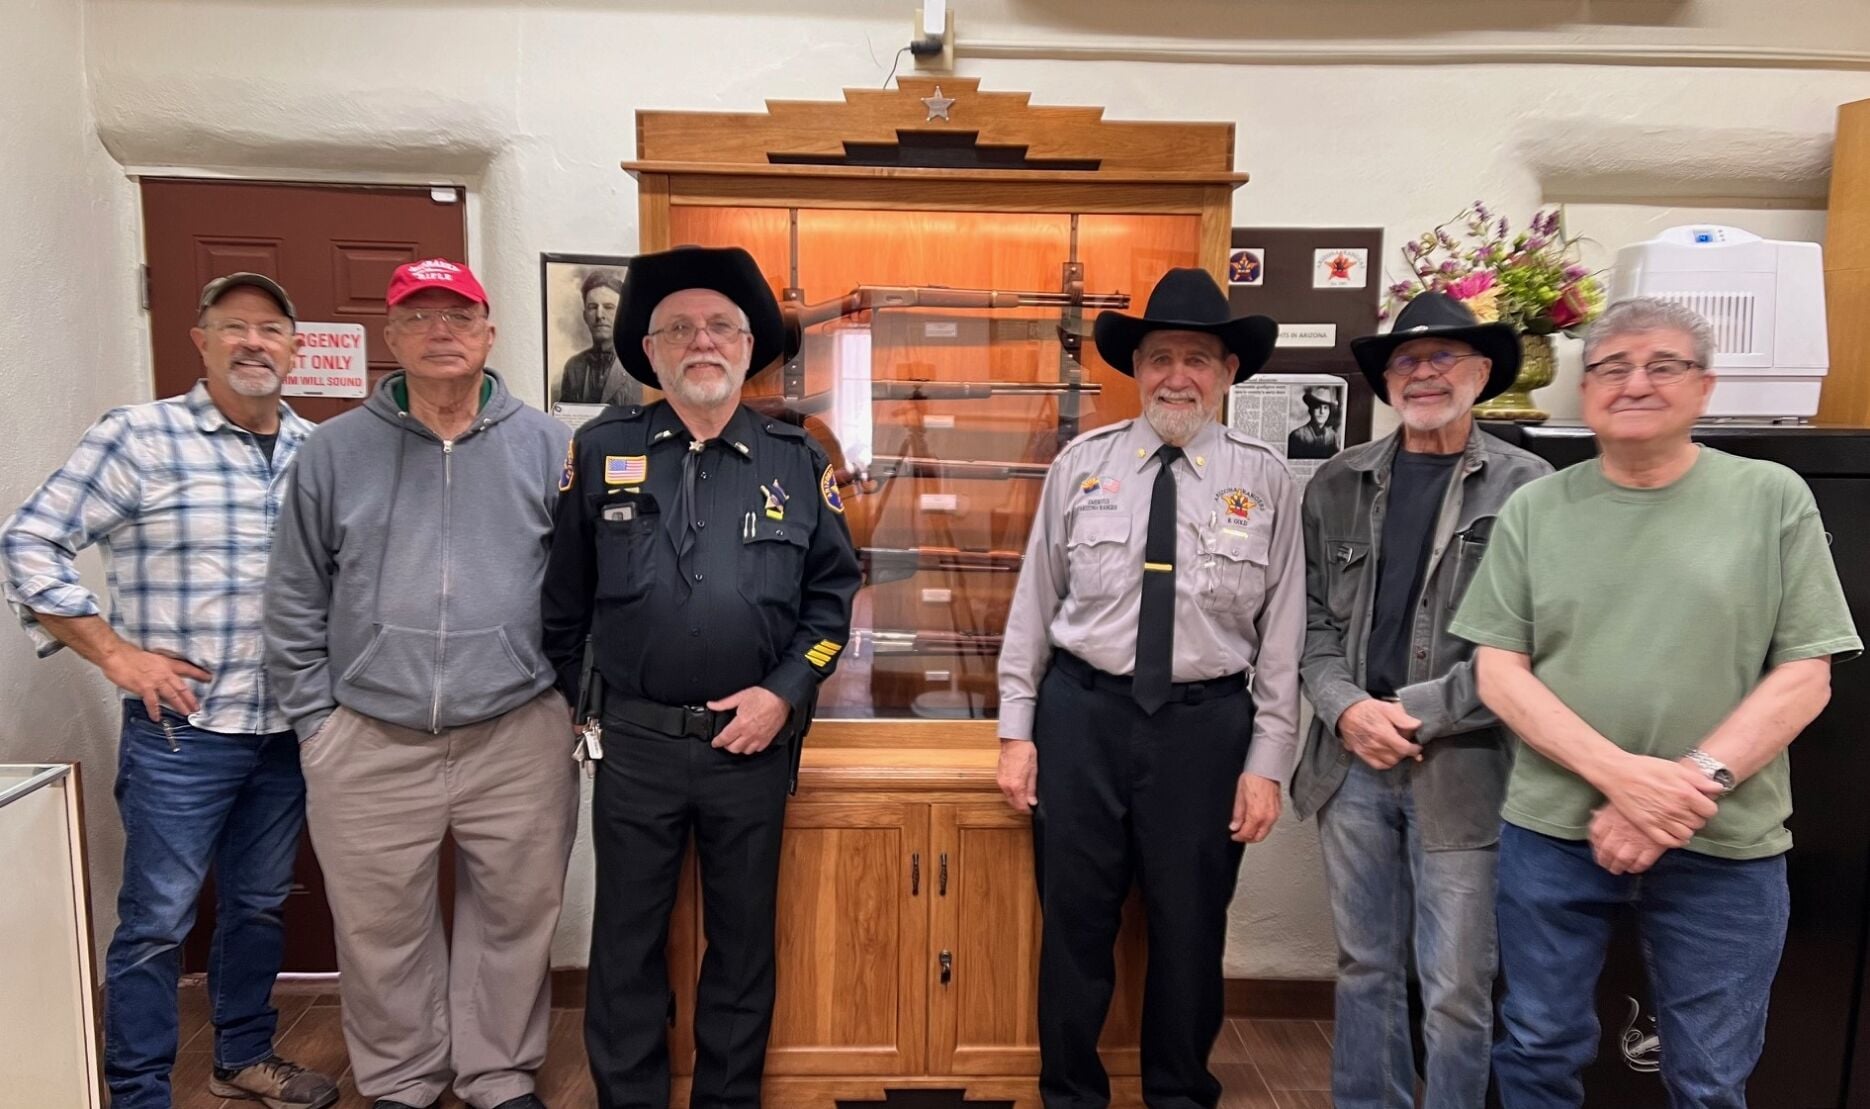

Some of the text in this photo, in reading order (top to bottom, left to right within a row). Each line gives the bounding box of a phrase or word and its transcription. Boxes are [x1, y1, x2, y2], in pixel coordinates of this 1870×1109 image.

[295, 332, 361, 348] RGENCY
[312, 354, 352, 370] ONLY
[301, 375, 325, 386] WILL
[326, 376, 362, 387] SOUND
[1233, 518, 1248, 526] GOLD
